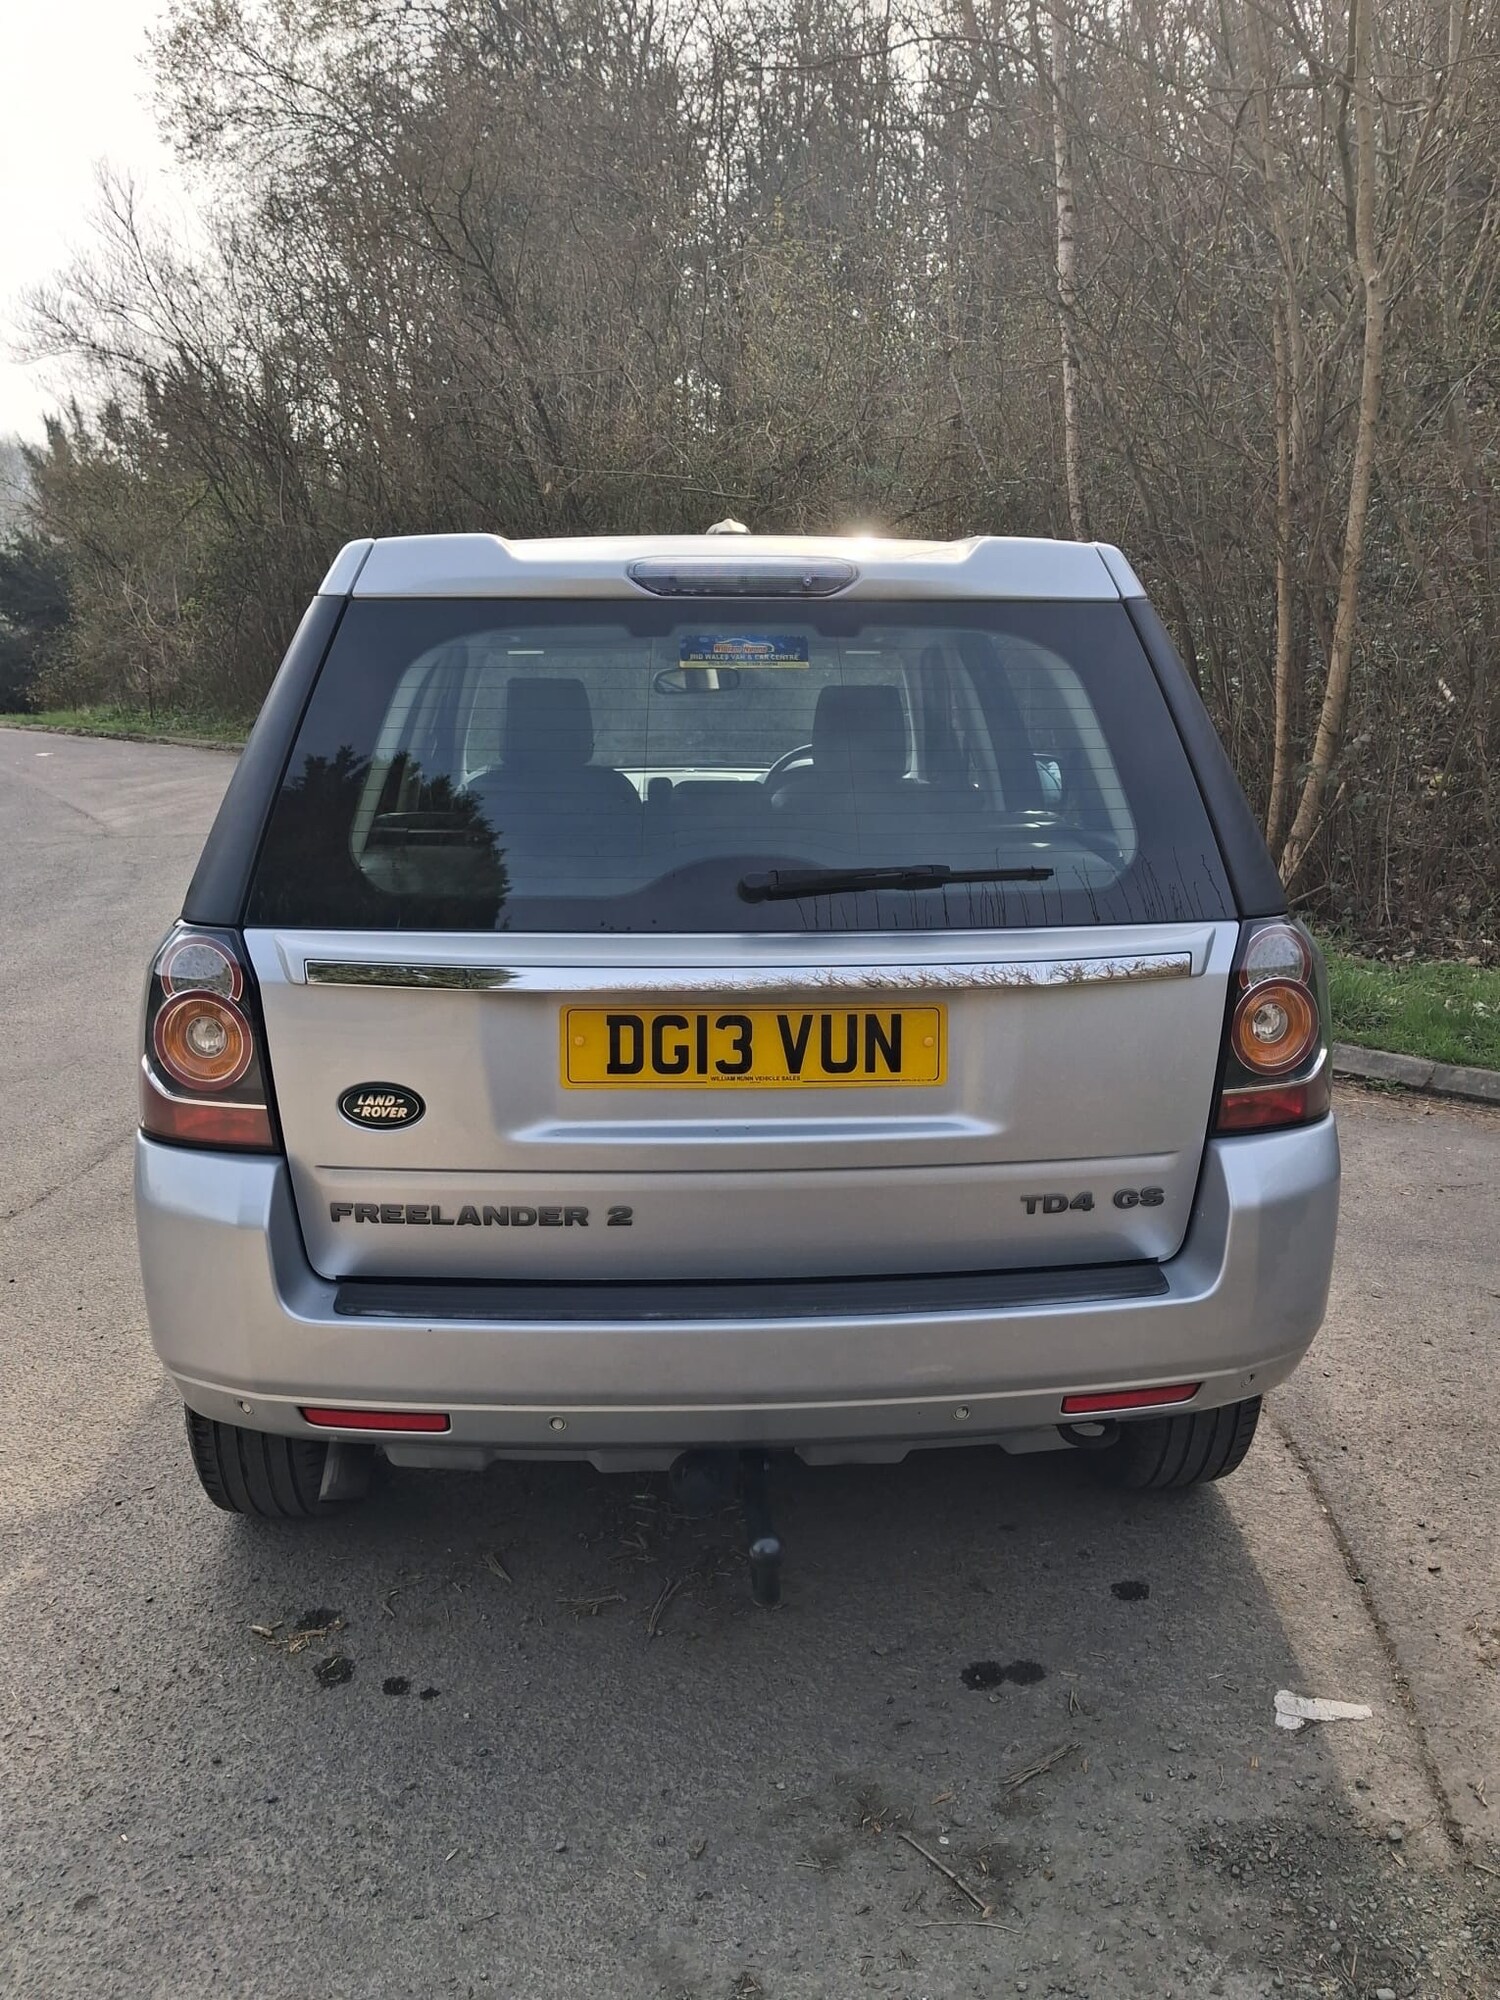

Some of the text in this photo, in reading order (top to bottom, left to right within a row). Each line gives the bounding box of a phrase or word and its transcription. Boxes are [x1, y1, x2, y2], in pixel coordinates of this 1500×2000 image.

[704, 653, 729, 661] WALES
[754, 653, 770, 661] CAR
[771, 653, 800, 661] CENTRE
[606, 1013, 903, 1075] DG13 VUN
[357, 1094, 396, 1106] LAND
[361, 1106, 408, 1118] ROVER
[1020, 1186, 1165, 1215] TD4 GS
[329, 1202, 634, 1227] FREELANDER 2
